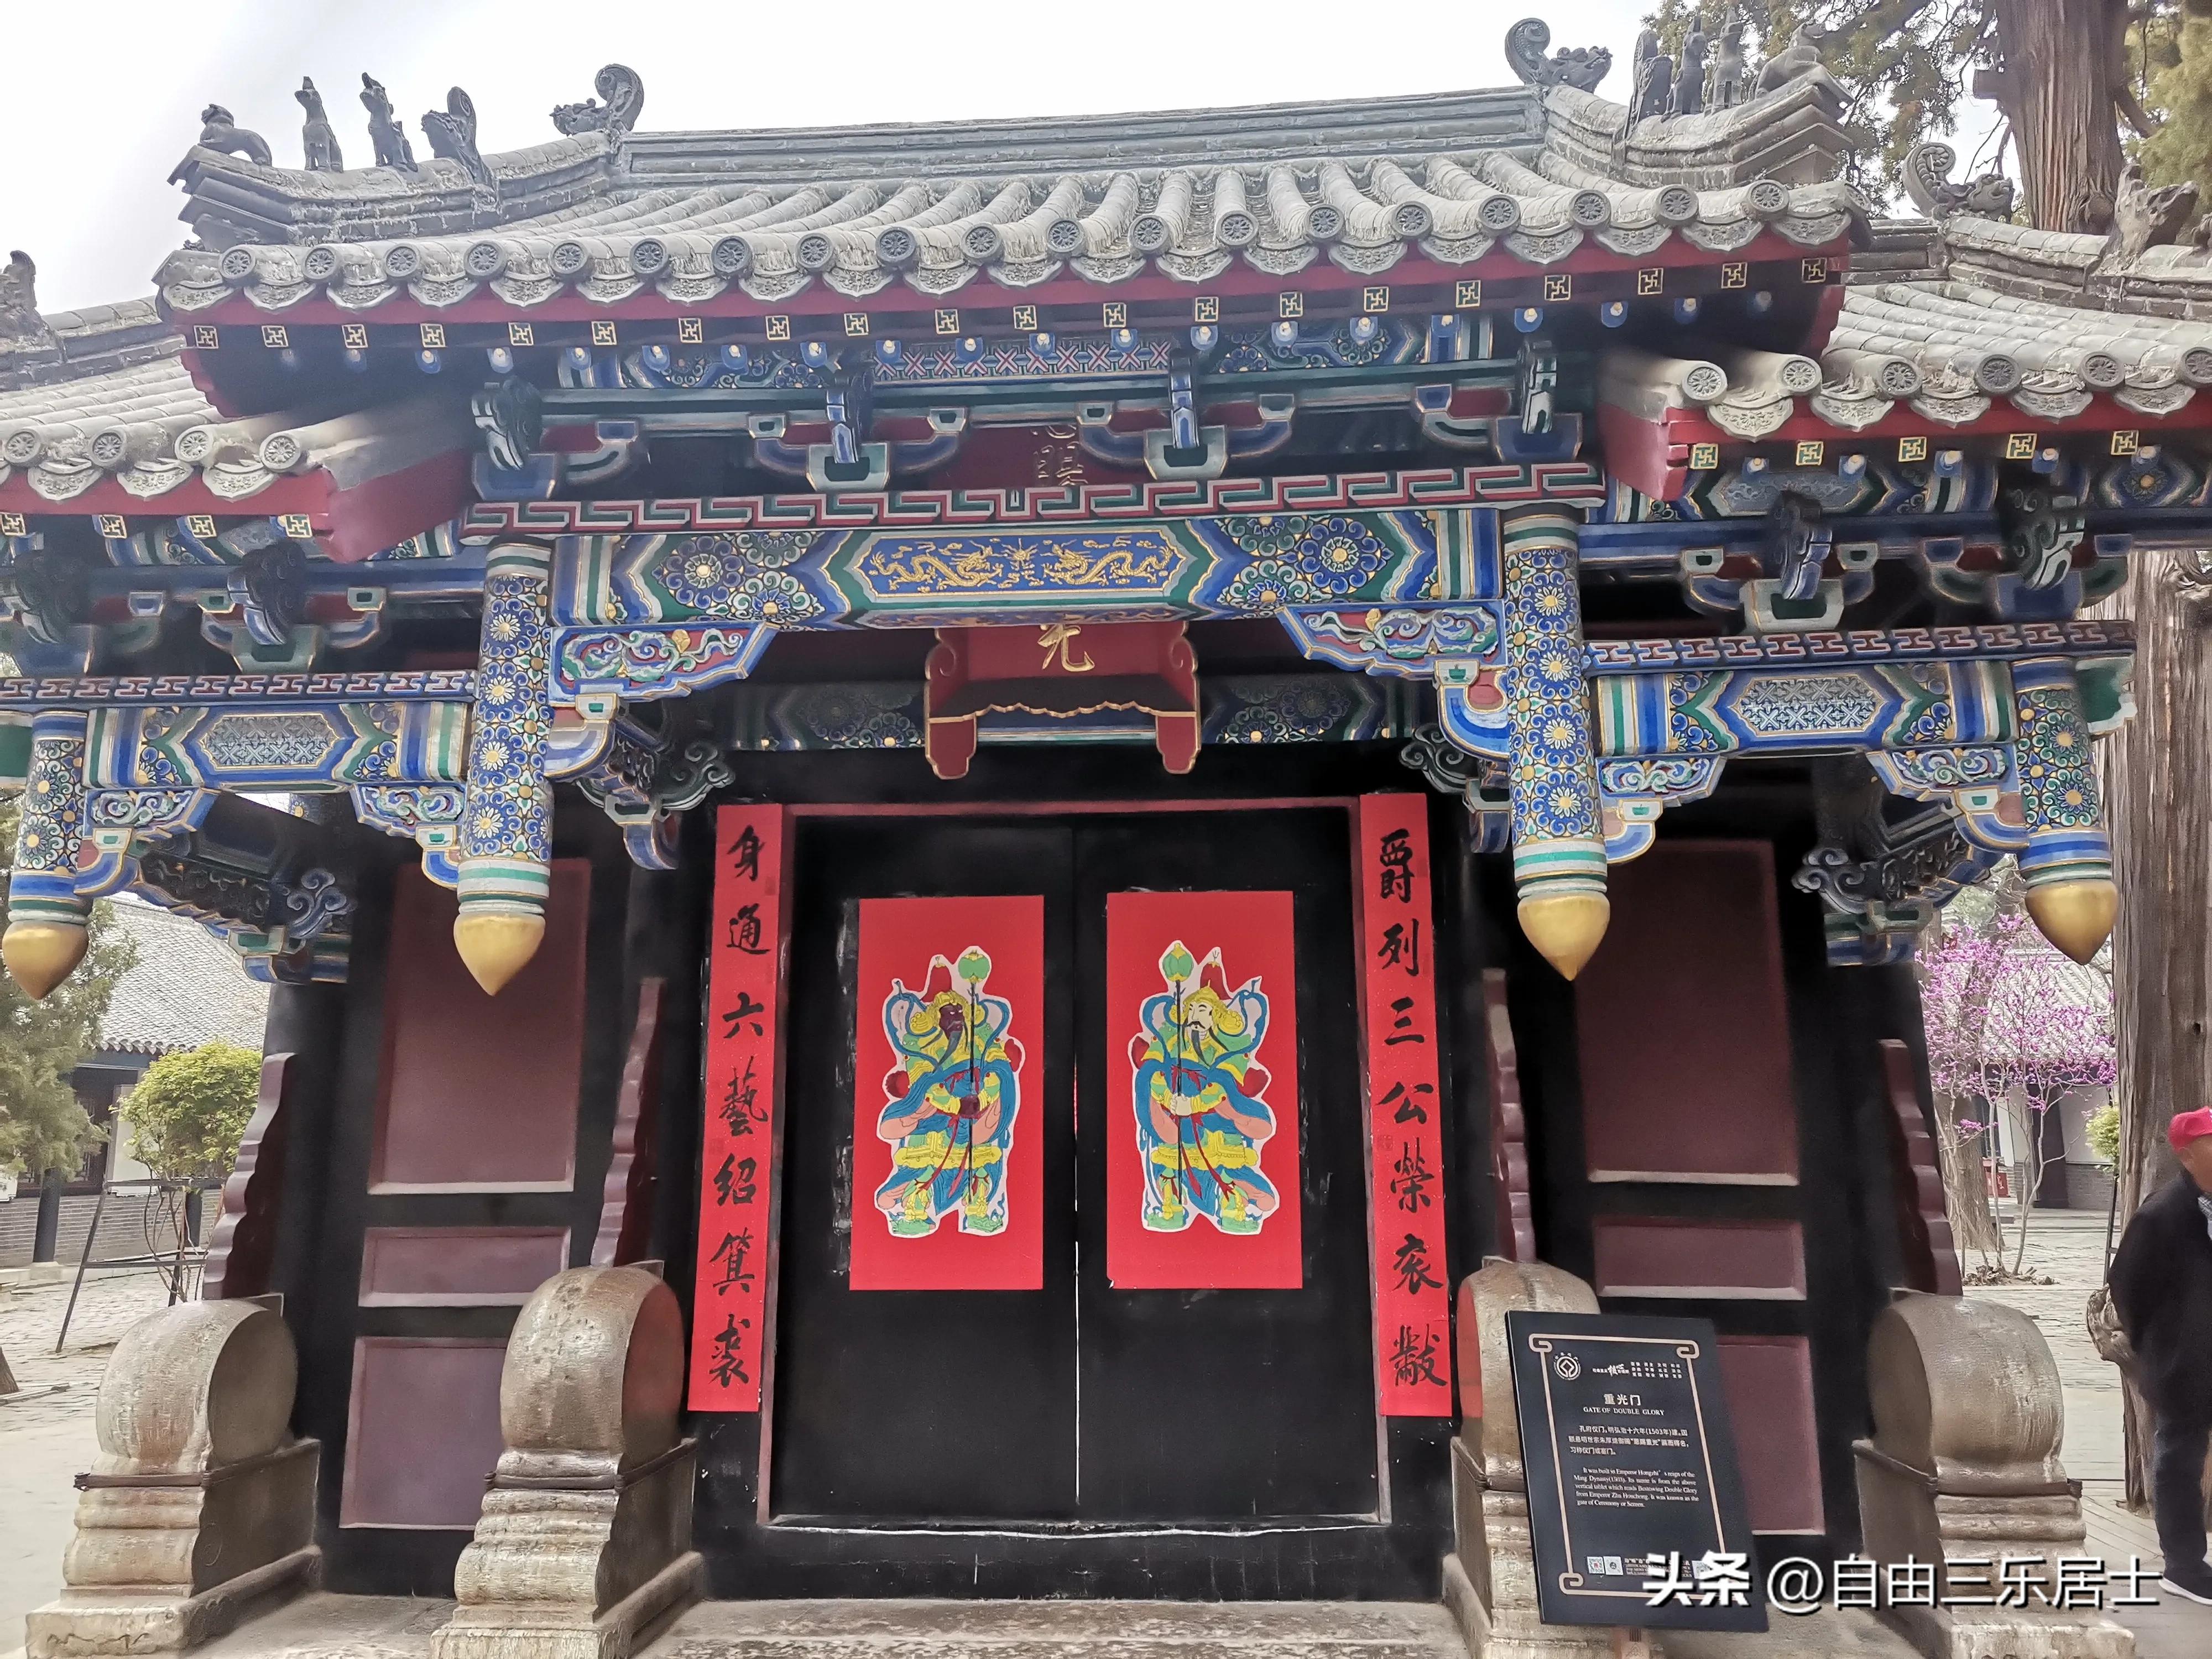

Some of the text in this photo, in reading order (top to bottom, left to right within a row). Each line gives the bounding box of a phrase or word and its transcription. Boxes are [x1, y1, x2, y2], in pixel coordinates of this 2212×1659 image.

[1604, 1394, 1641, 1406] 重光门
[1574, 1474, 1587, 1483] Ming
[1594, 1499, 1619, 1507] Ceremony
